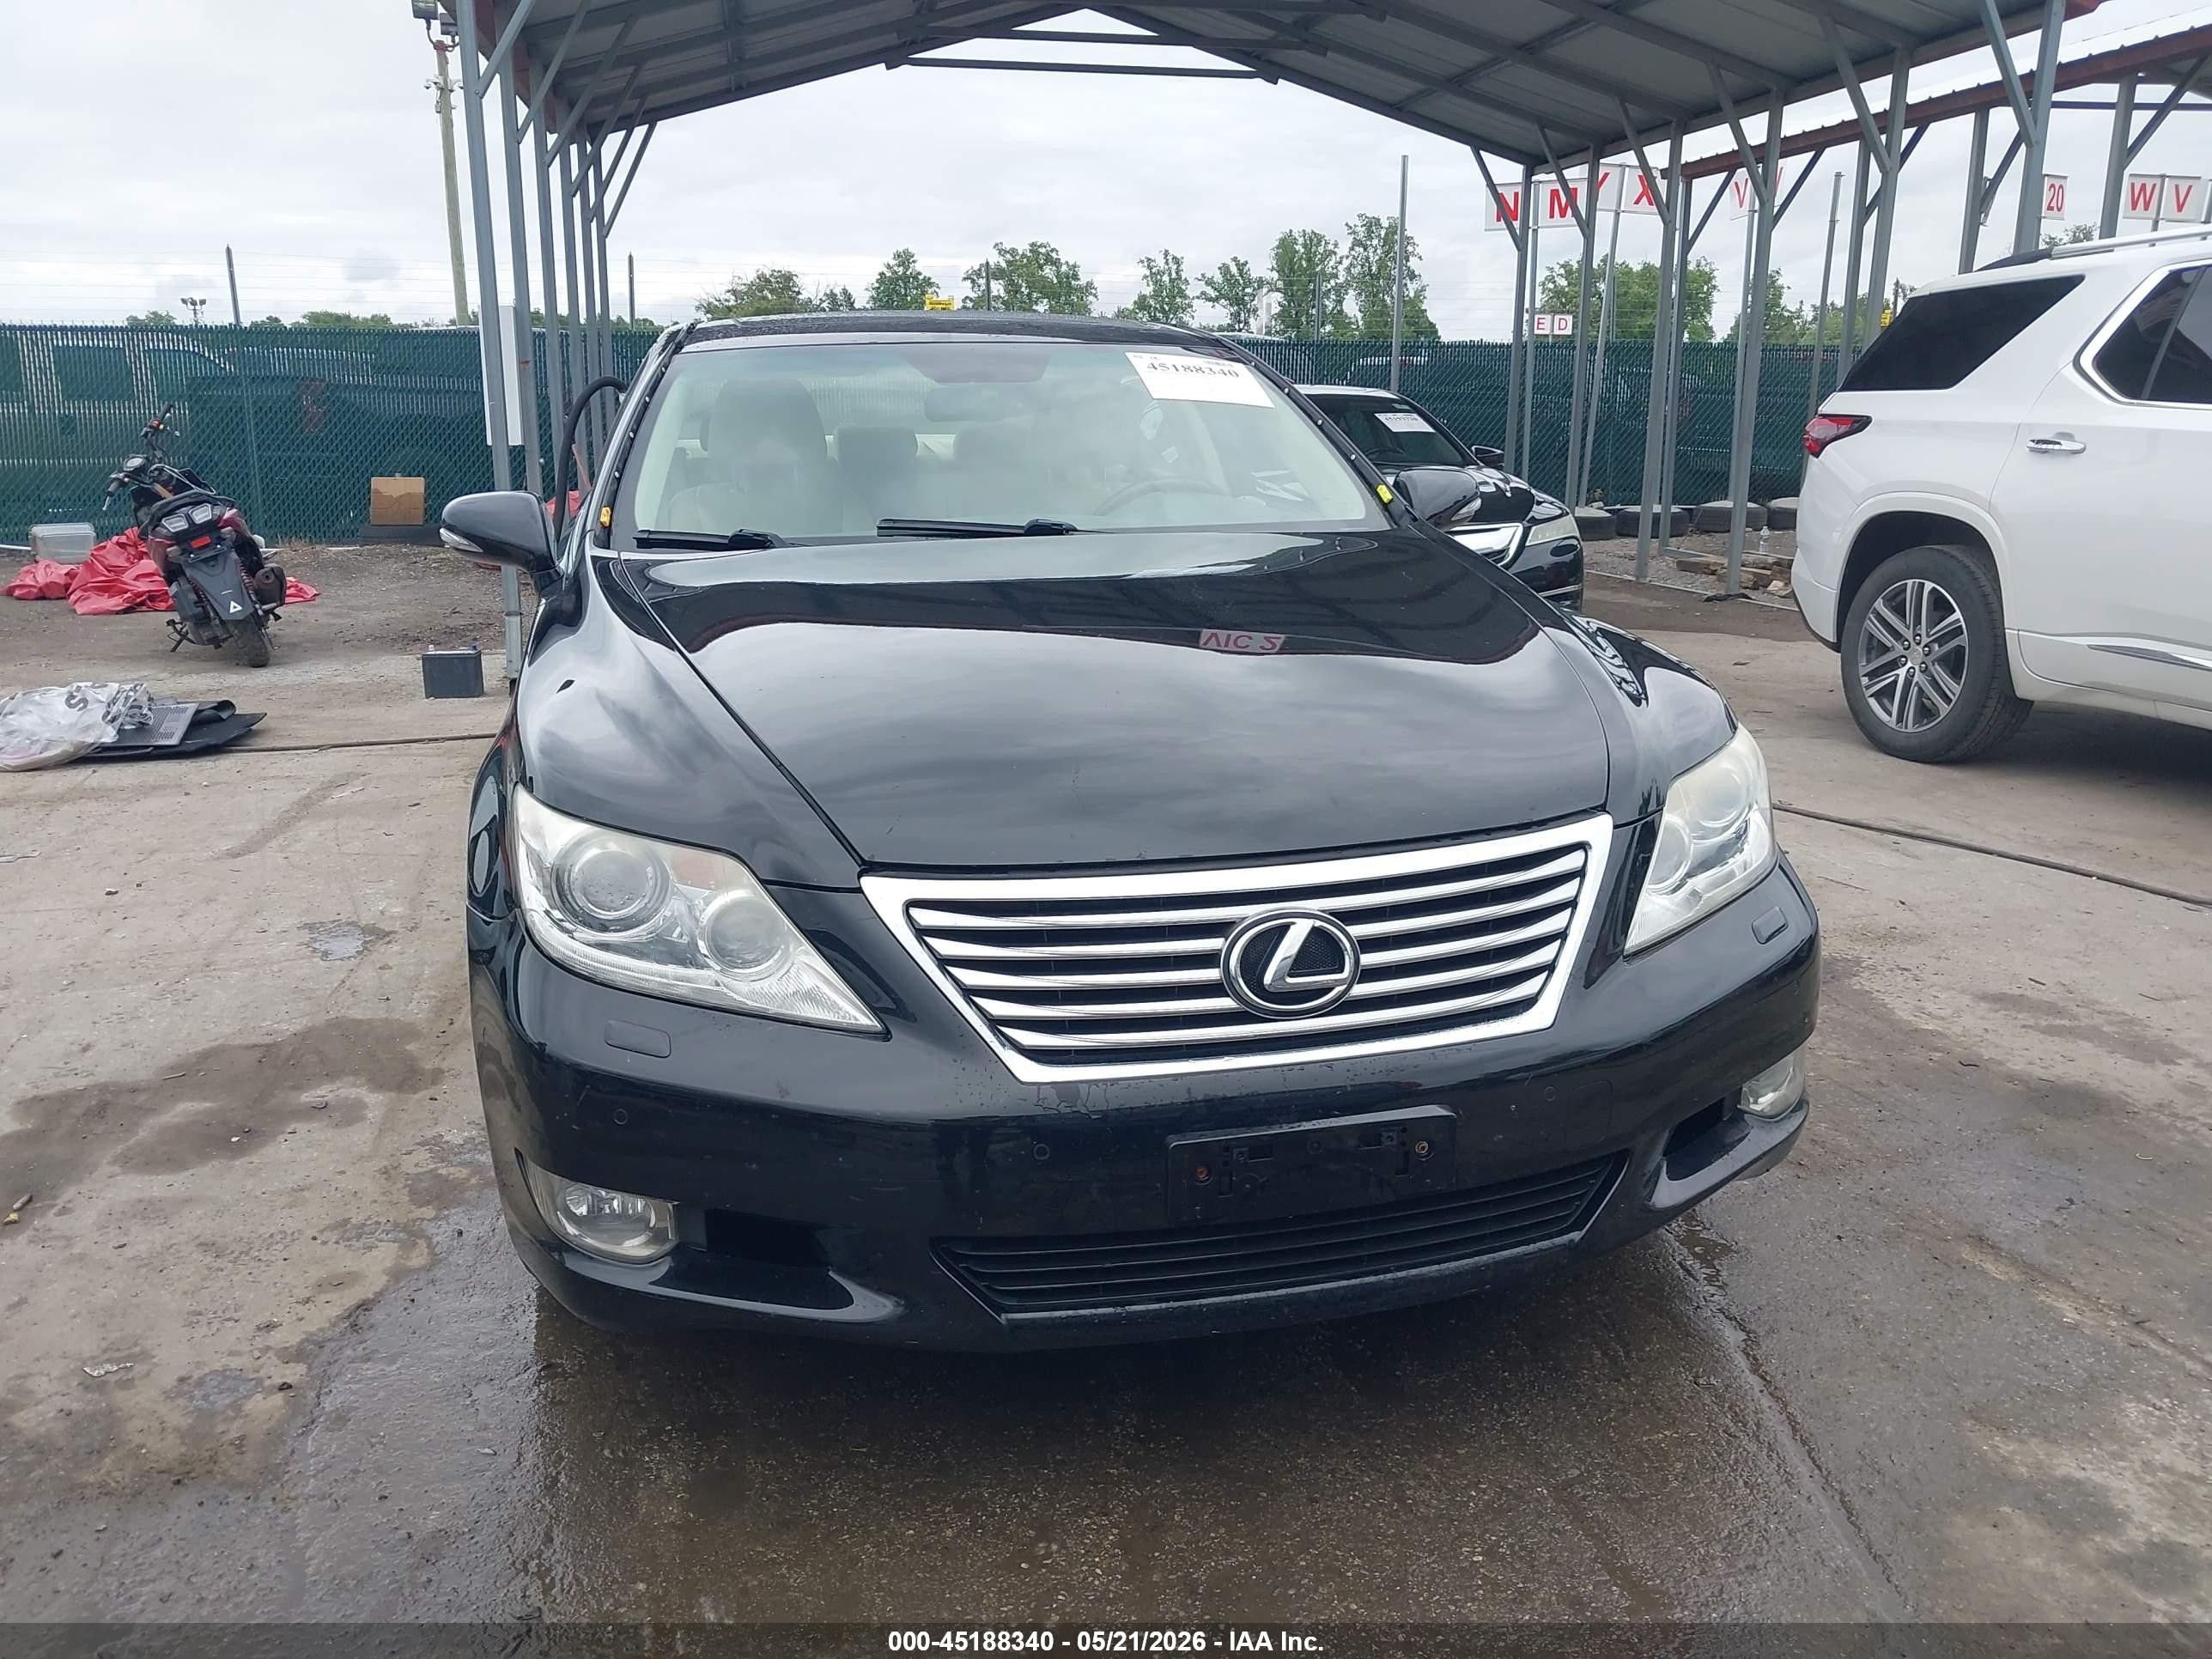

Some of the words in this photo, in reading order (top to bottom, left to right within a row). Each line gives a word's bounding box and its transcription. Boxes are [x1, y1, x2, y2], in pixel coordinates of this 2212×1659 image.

[1496, 191, 1520, 222] N
[1548, 186, 1579, 220] M
[2045, 182, 2065, 213] 20
[2130, 181, 2158, 212] W
[2173, 183, 2194, 214] V
[1535, 316, 1547, 331] E
[1558, 317, 1568, 331] D
[1146, 361, 1240, 379] 45188340
